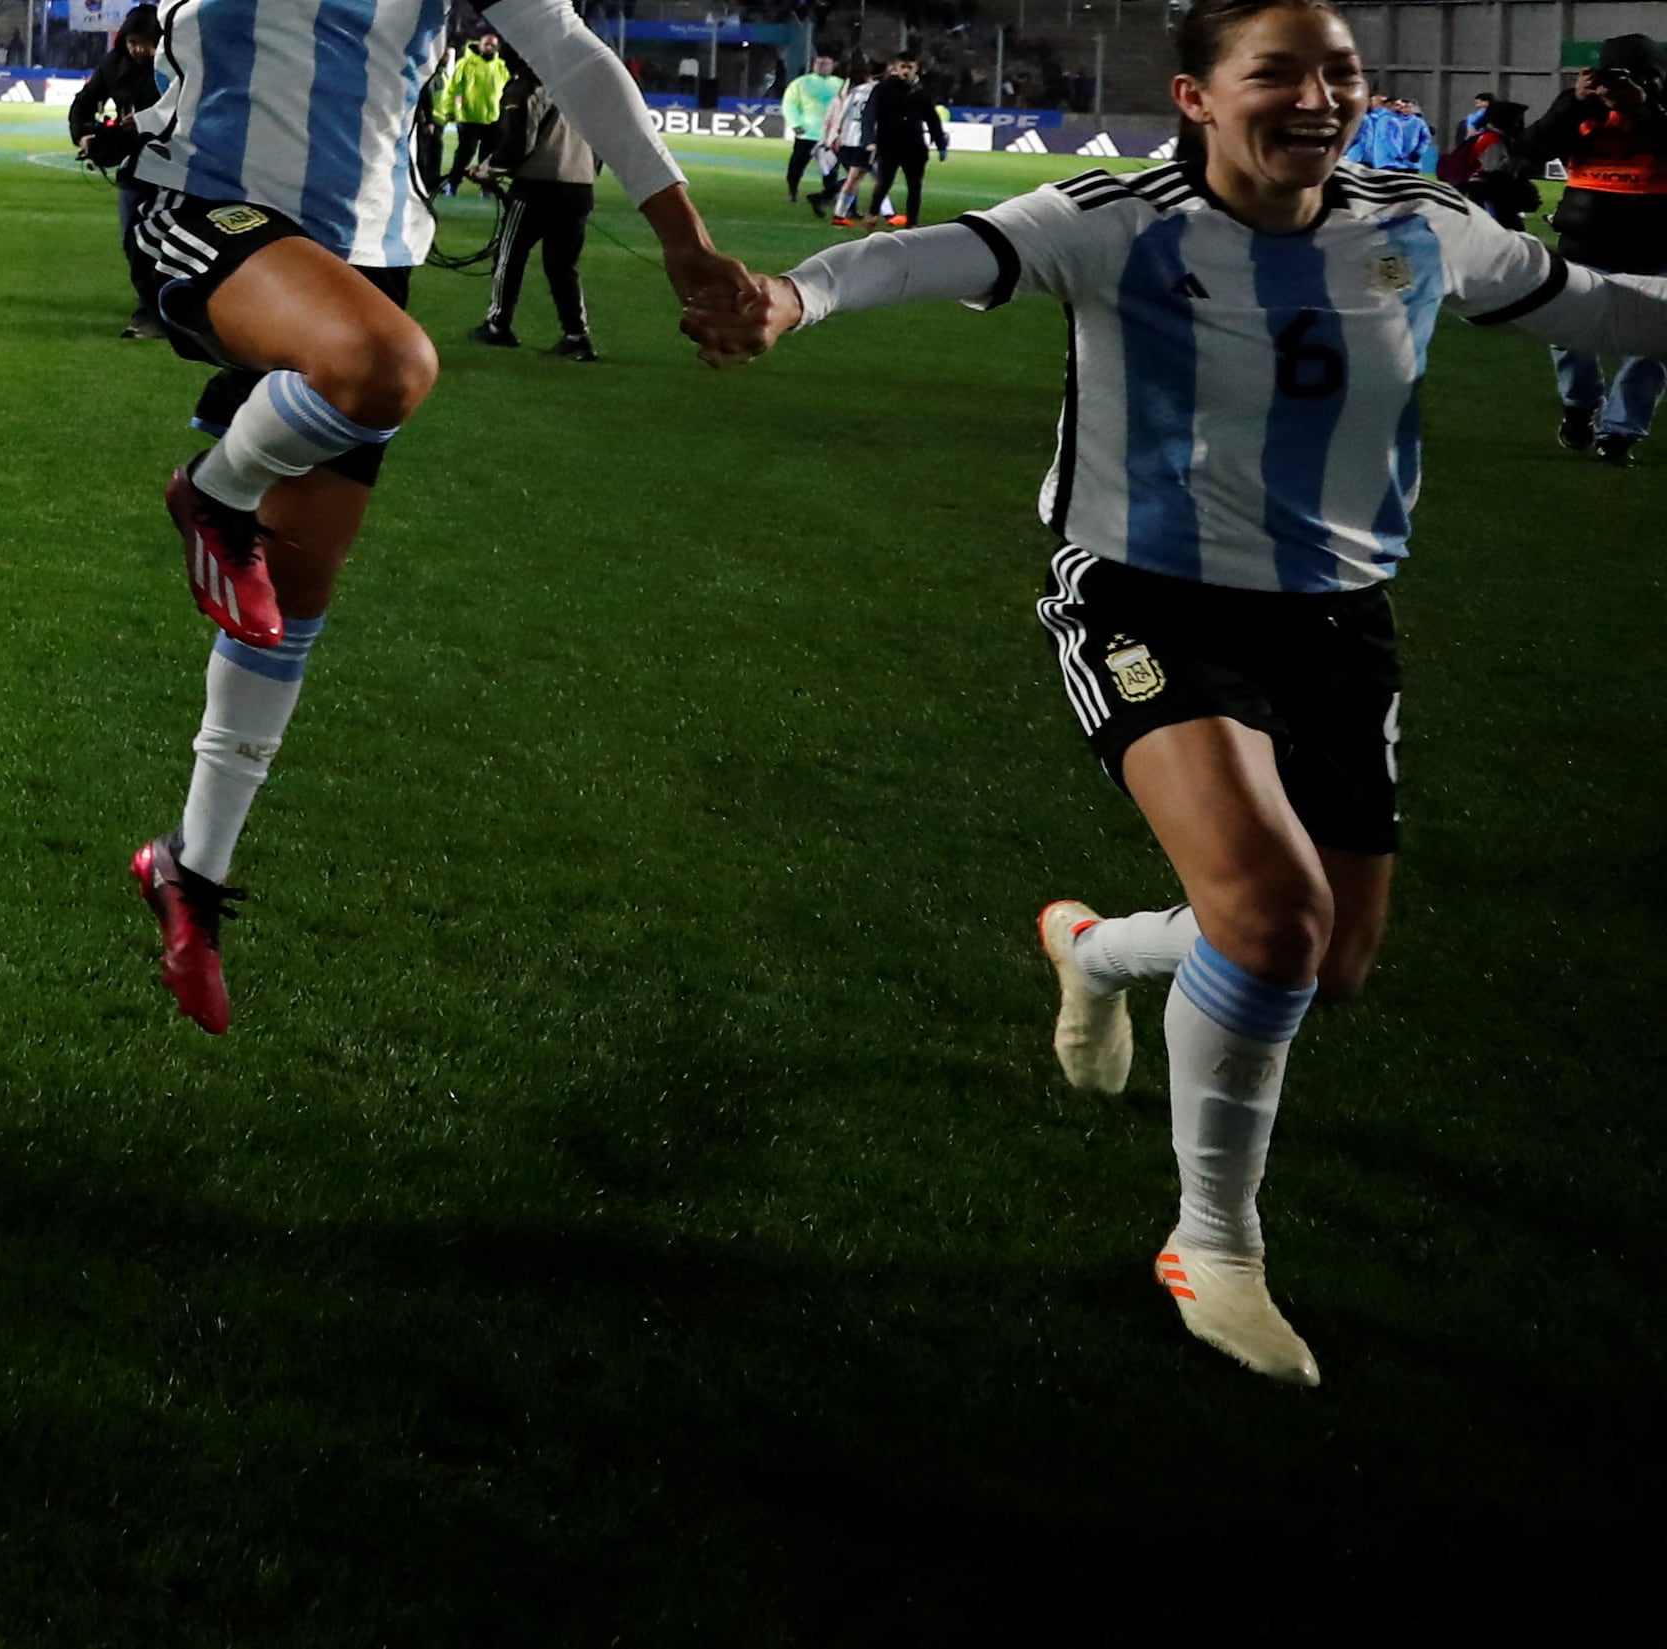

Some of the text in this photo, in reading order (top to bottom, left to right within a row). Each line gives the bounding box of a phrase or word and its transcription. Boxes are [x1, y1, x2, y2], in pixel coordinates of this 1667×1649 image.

[737, 103, 781, 116] YP
[961, 112, 1040, 128] YPF
[1277, 309, 1344, 398] 6
[1123, 661, 1152, 686] AFA
